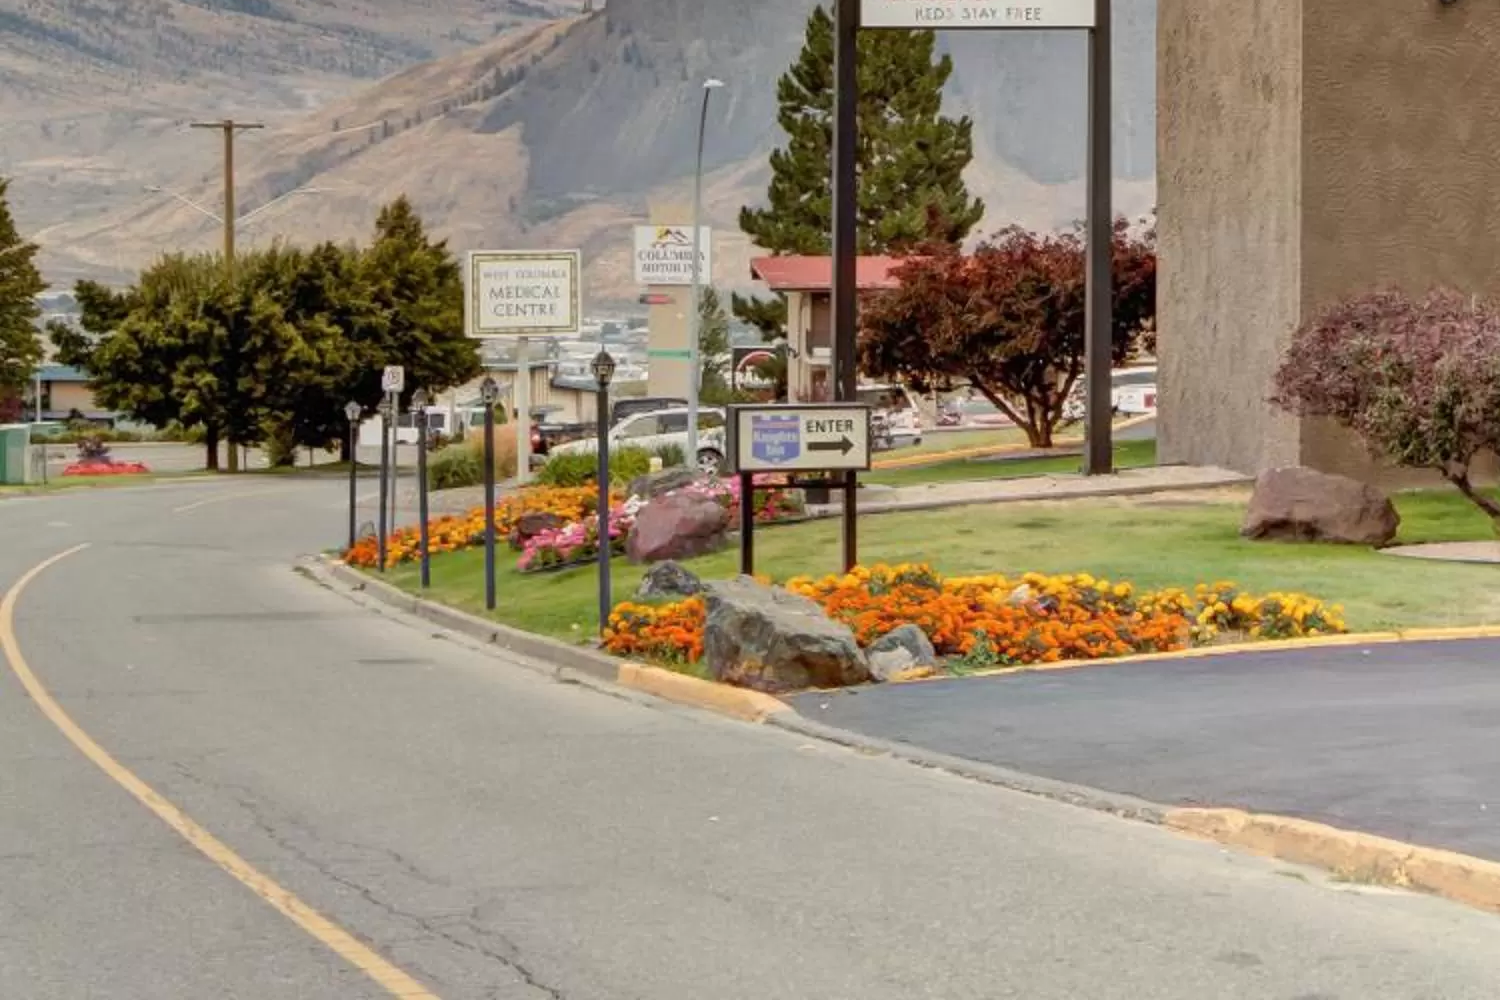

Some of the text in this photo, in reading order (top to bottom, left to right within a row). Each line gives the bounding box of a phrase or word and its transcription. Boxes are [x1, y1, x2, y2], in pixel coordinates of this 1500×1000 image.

[961, 7, 998, 21] STAY
[1006, 7, 1042, 21] FREE
[637, 250, 705, 261] COLUMBA
[489, 285, 561, 299] MEDICAL
[493, 303, 556, 317] CENTRE
[805, 419, 854, 433] ENTER
